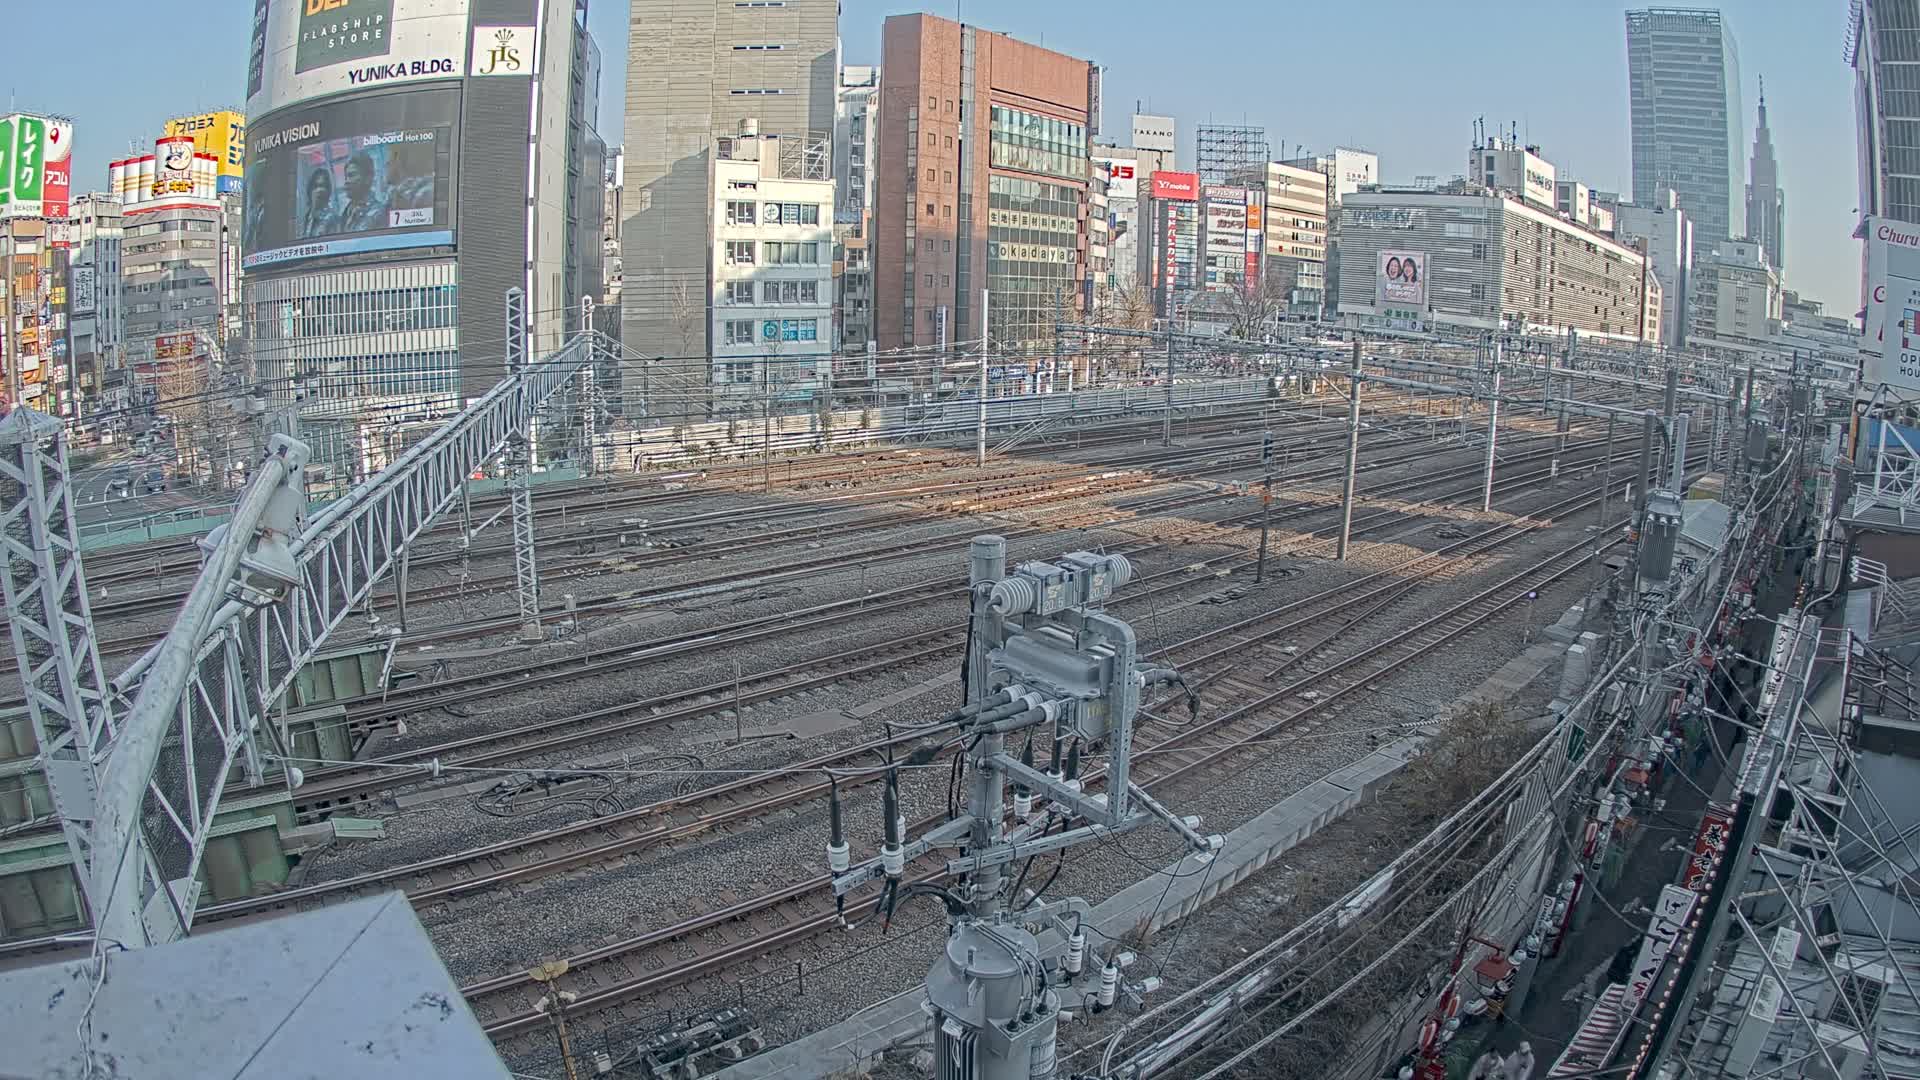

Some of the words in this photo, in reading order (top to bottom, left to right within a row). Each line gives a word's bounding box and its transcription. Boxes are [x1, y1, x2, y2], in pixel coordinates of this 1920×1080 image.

[303, 15, 383, 42] FLAGSHIP
[328, 29, 382, 48] STORE
[348, 63, 407, 85] YUNIKA
[411, 58, 455, 76] BLDG.
[175, 117, 215, 134] プロミス
[1134, 128, 1173, 137] TAKANO
[254, 132, 281, 153] YUNIKA
[282, 121, 320, 145] VISION
[363, 132, 403, 146] billboard
[405, 134, 419, 142] Hot
[419, 132, 433, 141] 100
[21, 121, 37, 189] レイク
[46, 170, 68, 186] アコム
[1878, 225, 1919, 247] Churu
[1000, 245, 1064, 260] okadaya
[1900, 353, 1920, 365] OP
